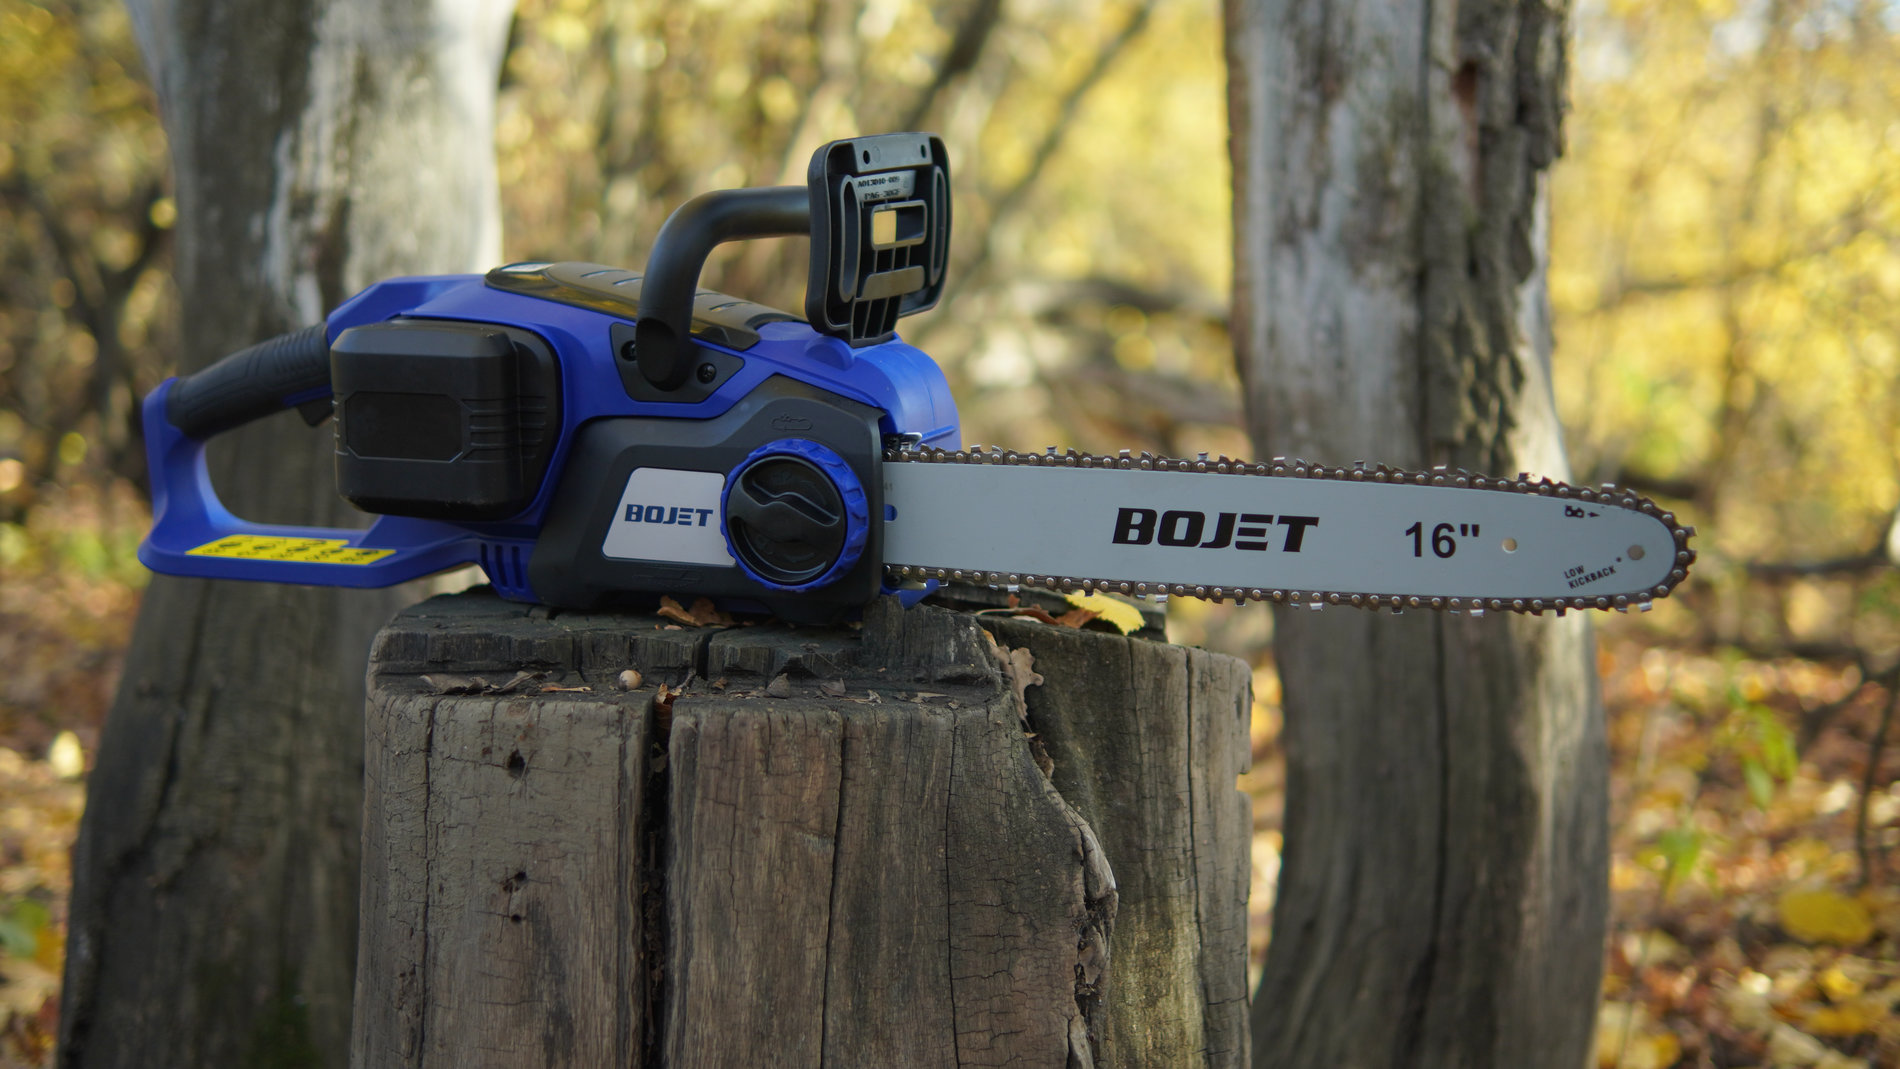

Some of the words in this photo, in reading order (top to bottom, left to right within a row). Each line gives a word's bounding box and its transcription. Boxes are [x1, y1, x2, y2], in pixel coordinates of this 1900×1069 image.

[624, 504, 713, 527] BOJET
[1112, 507, 1319, 552] BOJET
[1405, 521, 1479, 558] 16"
[1564, 565, 1585, 579] LOW
[1568, 565, 1616, 589] KICKBACK
